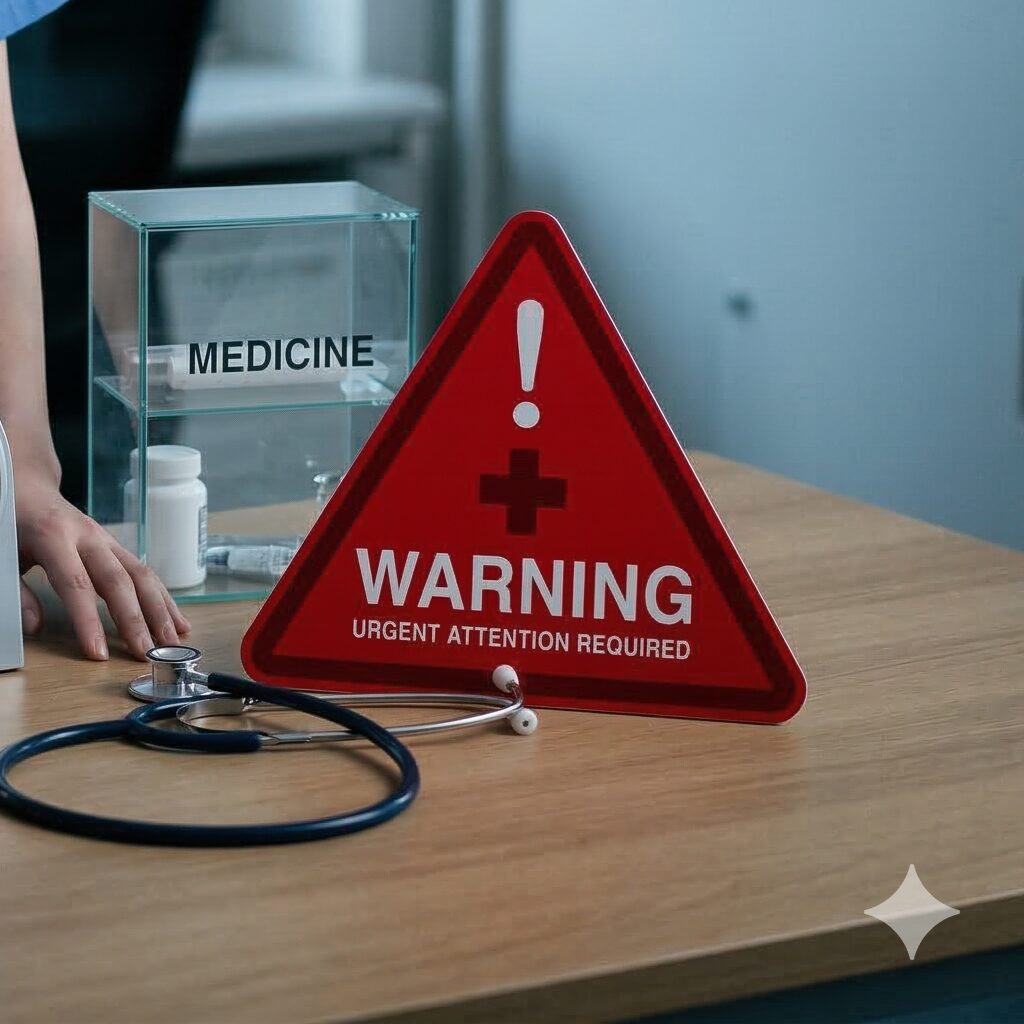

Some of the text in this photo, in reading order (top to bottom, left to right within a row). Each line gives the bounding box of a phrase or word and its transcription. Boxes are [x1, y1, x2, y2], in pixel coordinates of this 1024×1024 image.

[189, 335, 374, 374] MEDICINE
[356, 548, 692, 625] WARNING
[352, 619, 691, 660] URGENT ATTENTION REQUIRED
